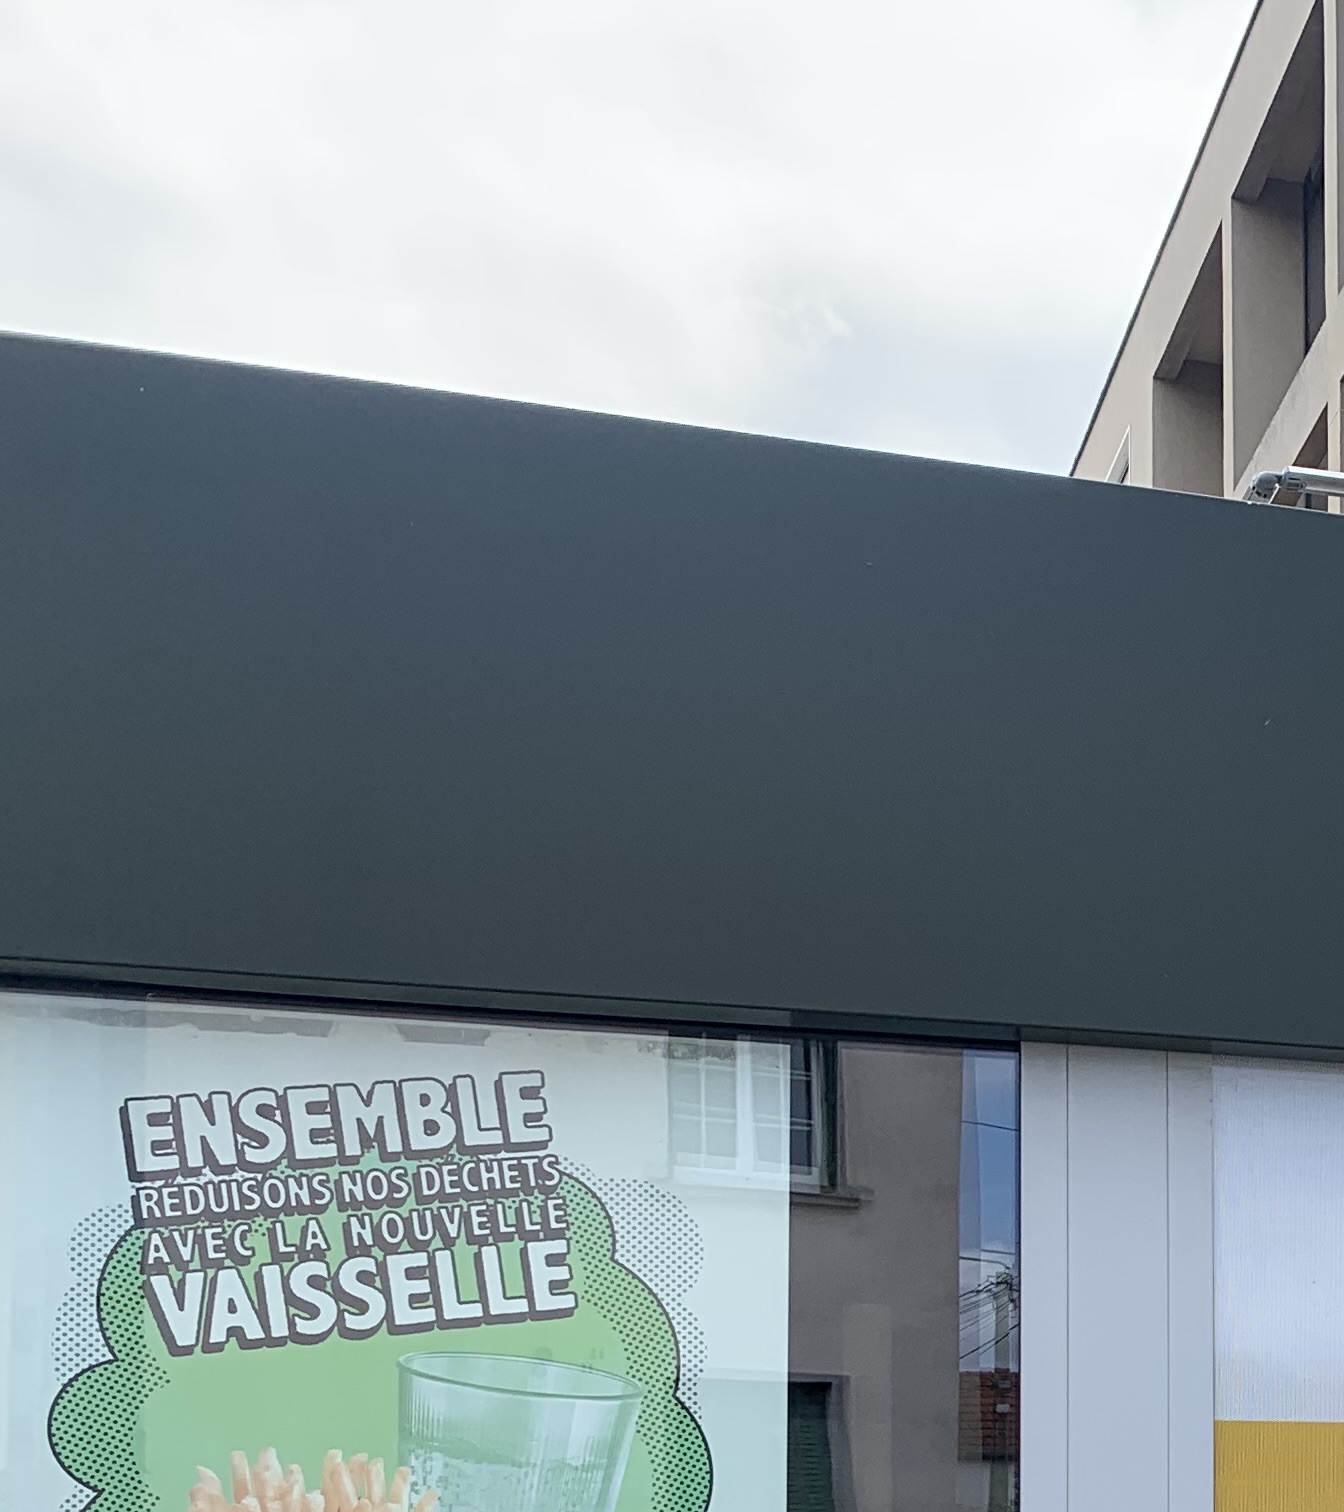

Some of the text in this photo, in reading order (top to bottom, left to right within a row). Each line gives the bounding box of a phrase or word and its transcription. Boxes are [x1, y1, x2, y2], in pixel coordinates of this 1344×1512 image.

[121, 1070, 553, 1180] ENSEMBLE
[340, 1167, 410, 1204] NOS
[147, 1197, 569, 1265] AVEC LA NOUVELLE
[146, 1239, 578, 1354] VAISSELLE
